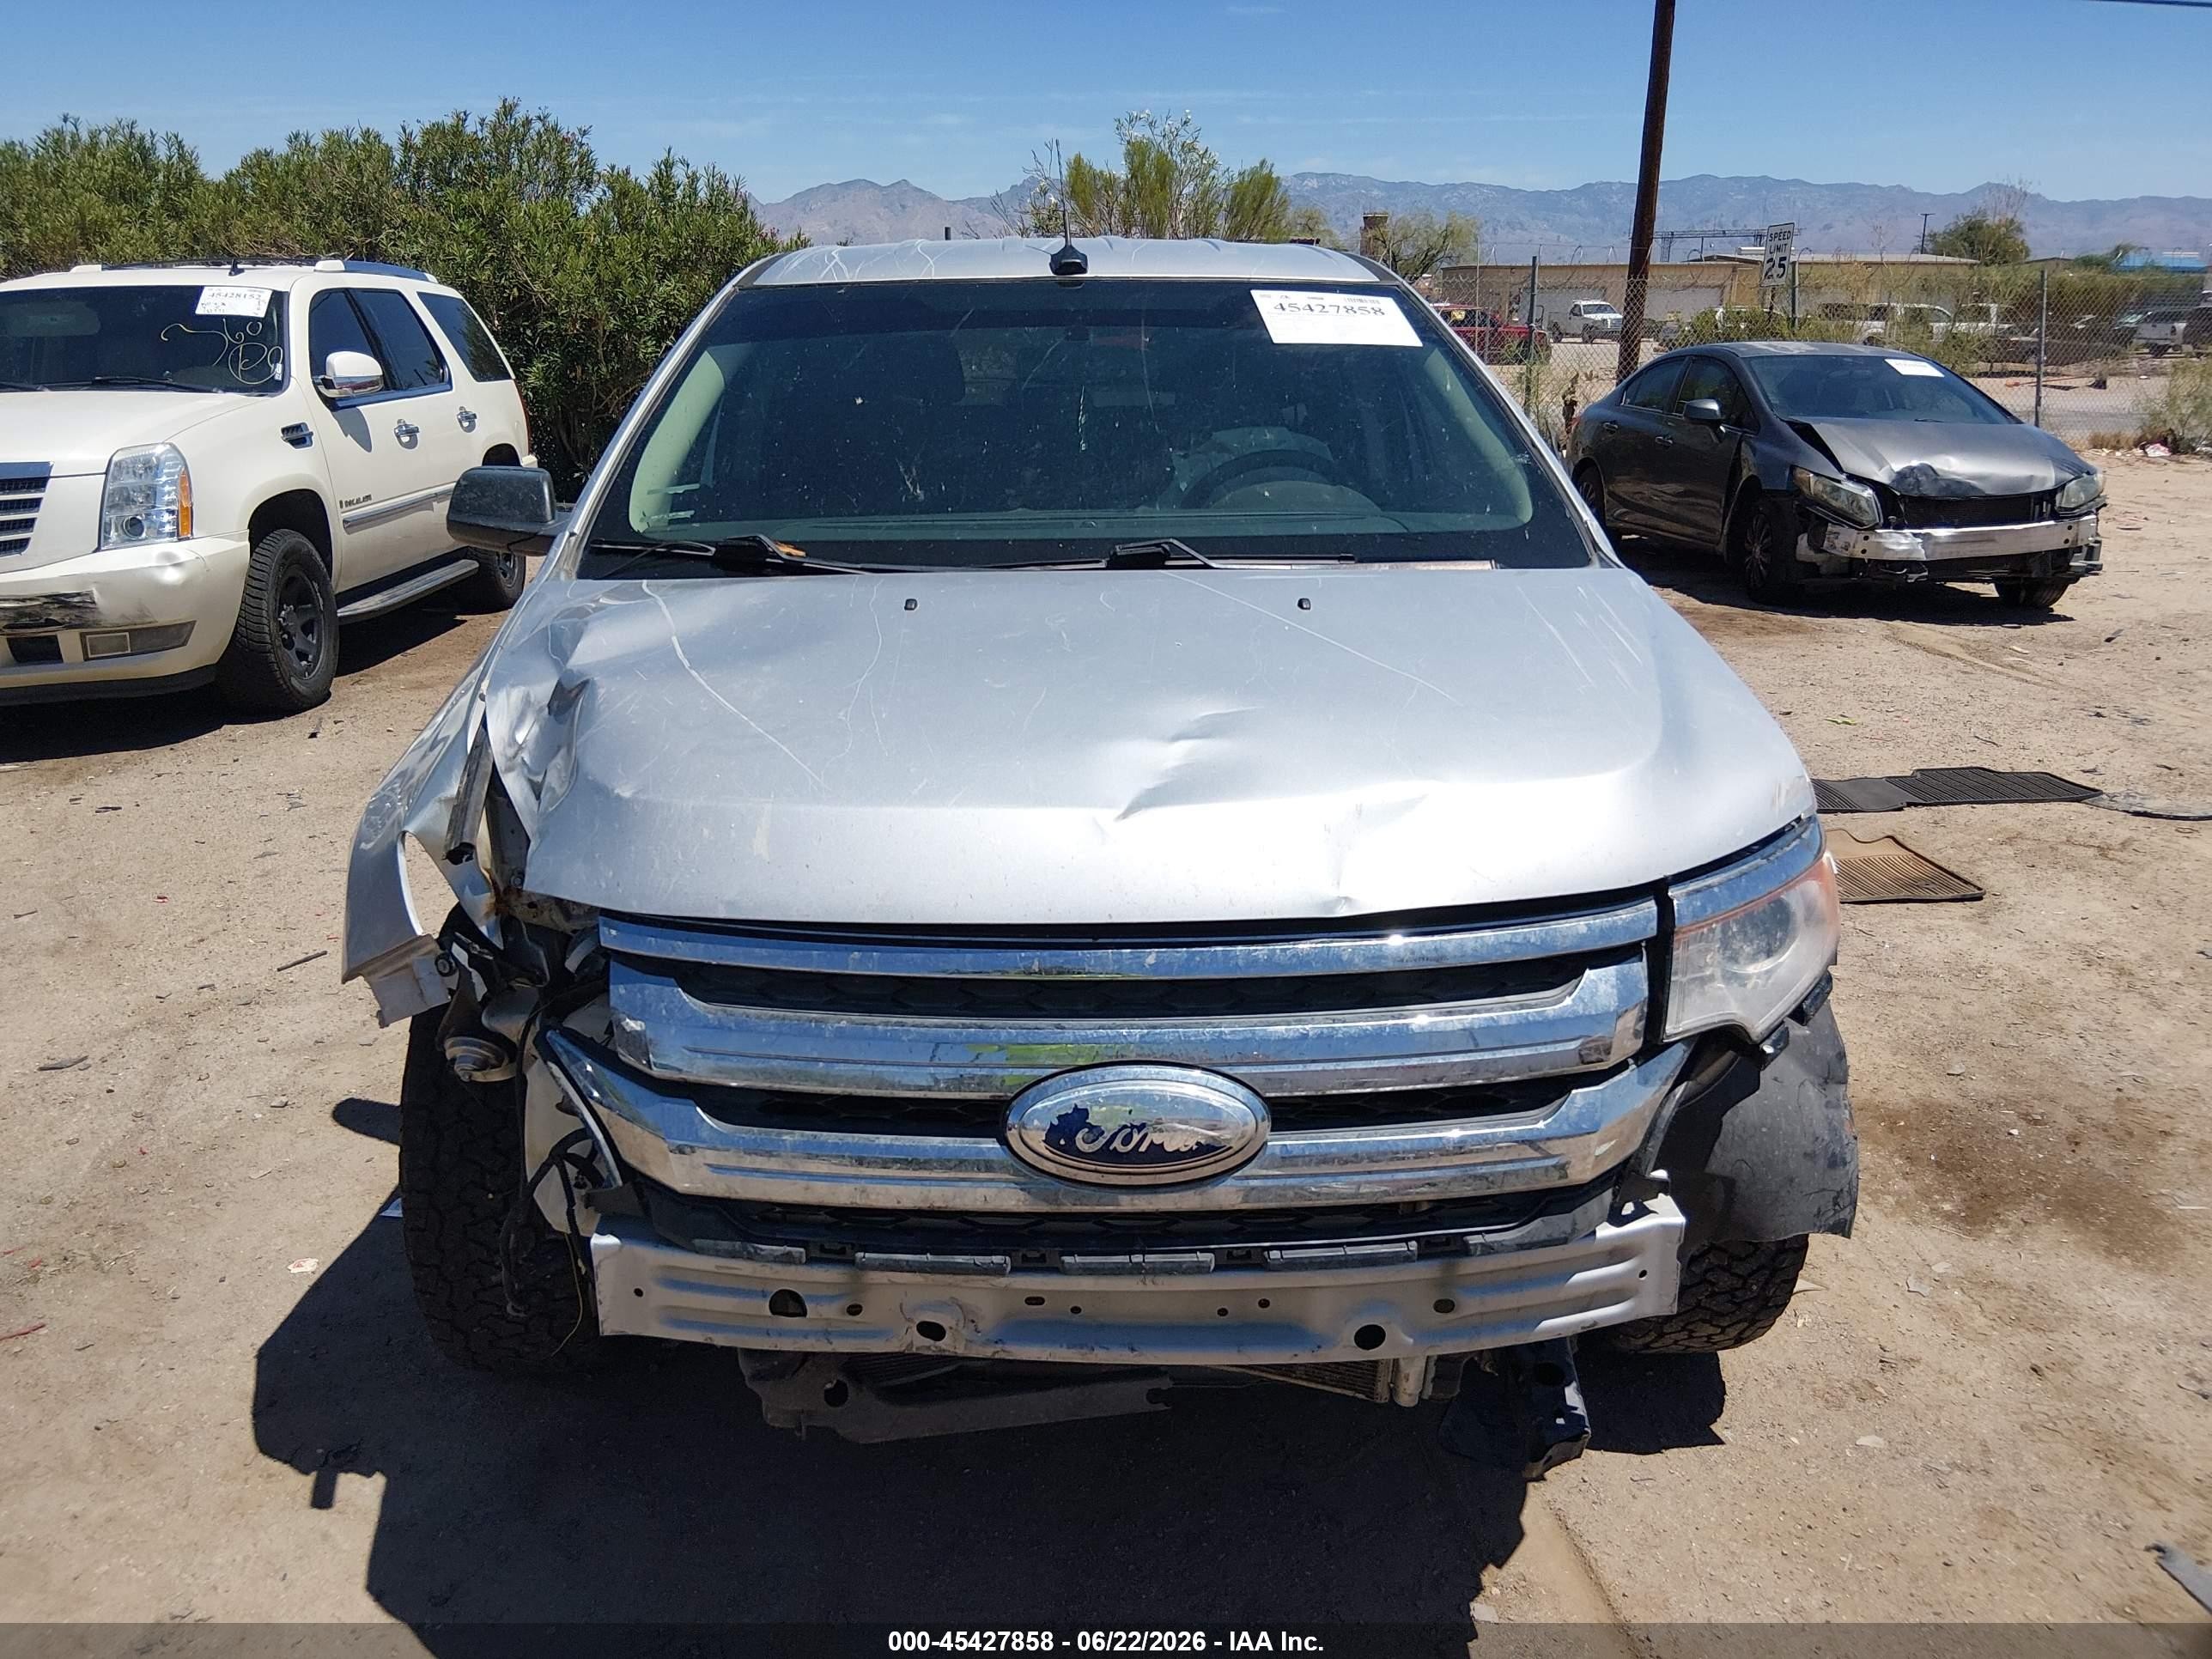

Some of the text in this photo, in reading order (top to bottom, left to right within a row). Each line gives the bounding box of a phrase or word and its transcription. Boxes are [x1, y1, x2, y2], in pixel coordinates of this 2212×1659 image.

[1769, 230, 1791, 241] SPEED
[1769, 243, 1788, 254] LIMIT
[1765, 257, 1787, 279] 25
[1273, 302, 1386, 317] 45427858
